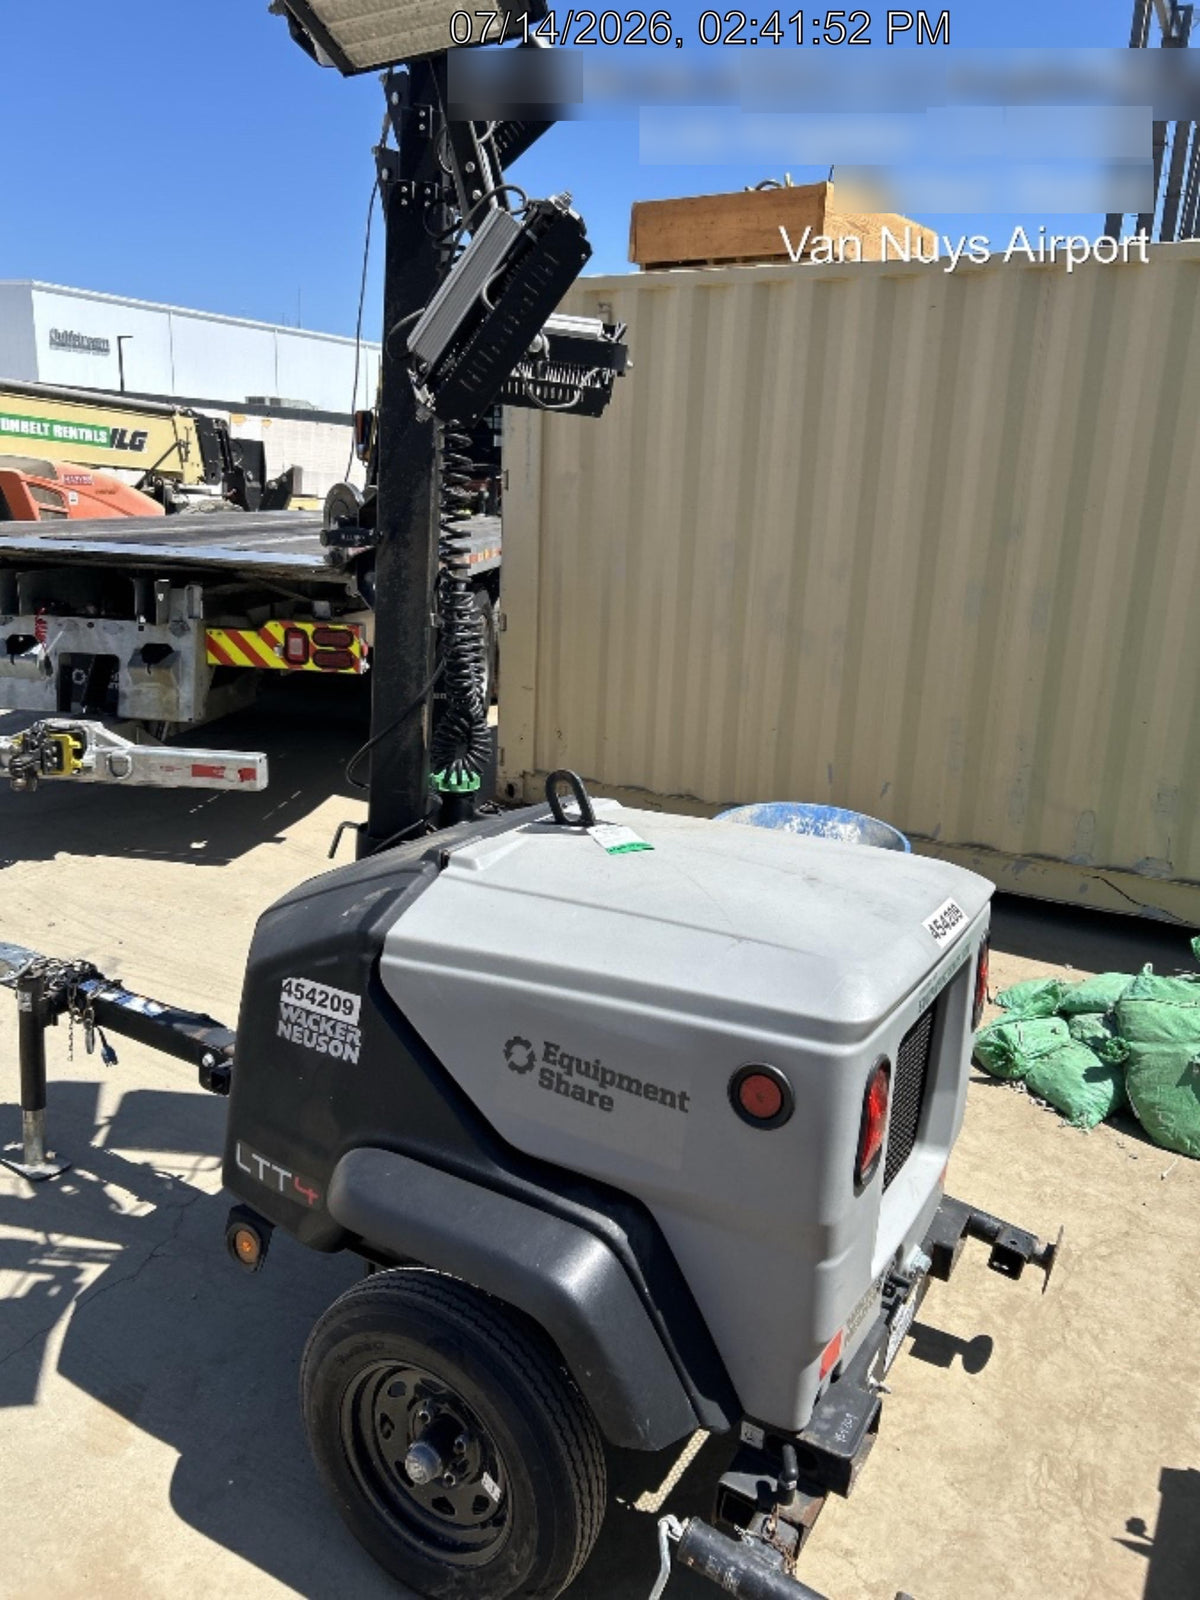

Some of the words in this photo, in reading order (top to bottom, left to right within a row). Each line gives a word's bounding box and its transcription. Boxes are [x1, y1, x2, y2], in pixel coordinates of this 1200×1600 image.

[53, 424, 107, 443] RENTALS
[282, 980, 354, 1016] 454209
[277, 1019, 360, 1065] NEUSON
[280, 1001, 361, 1047] WACKER
[538, 1067, 615, 1112] Share
[542, 1041, 690, 1113] Equipment
[236, 1142, 319, 1205] LTT4
